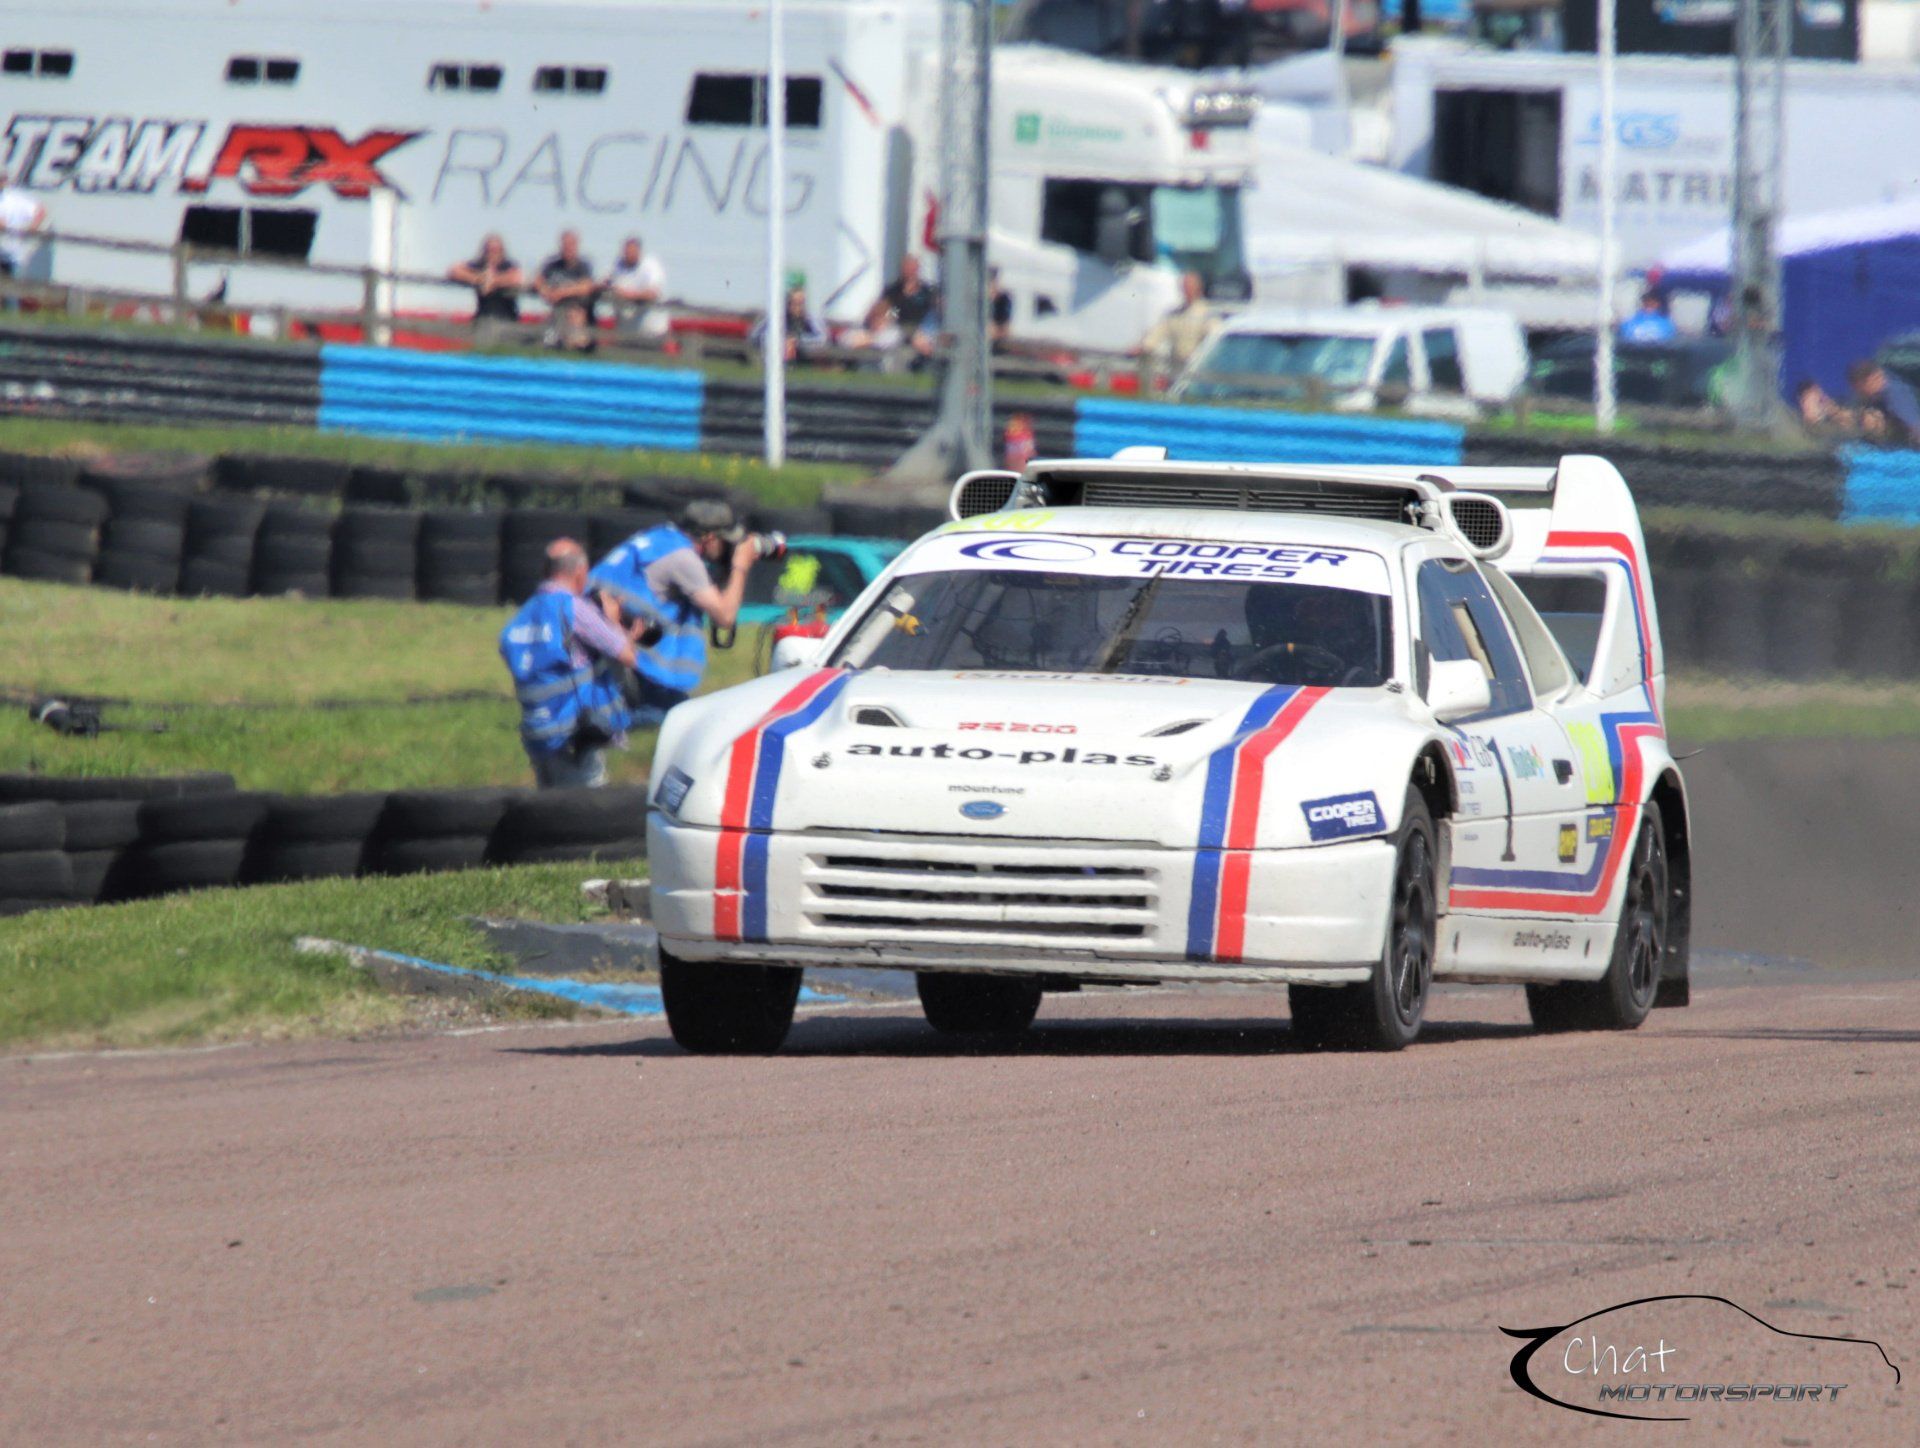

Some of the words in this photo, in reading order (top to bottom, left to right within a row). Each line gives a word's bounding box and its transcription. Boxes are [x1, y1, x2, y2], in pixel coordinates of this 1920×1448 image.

[3, 114, 207, 194] TEAM
[208, 124, 428, 201] RX
[431, 129, 822, 213] RACING
[1111, 541, 1349, 566] COOPER
[1139, 559, 1302, 578] TIRES
[847, 743, 1157, 766] auto-plas
[948, 784, 1025, 796] mountune
[1309, 799, 1376, 822] COOPER
[1343, 813, 1377, 828] TIRES
[1513, 930, 1571, 953] auto-plas
